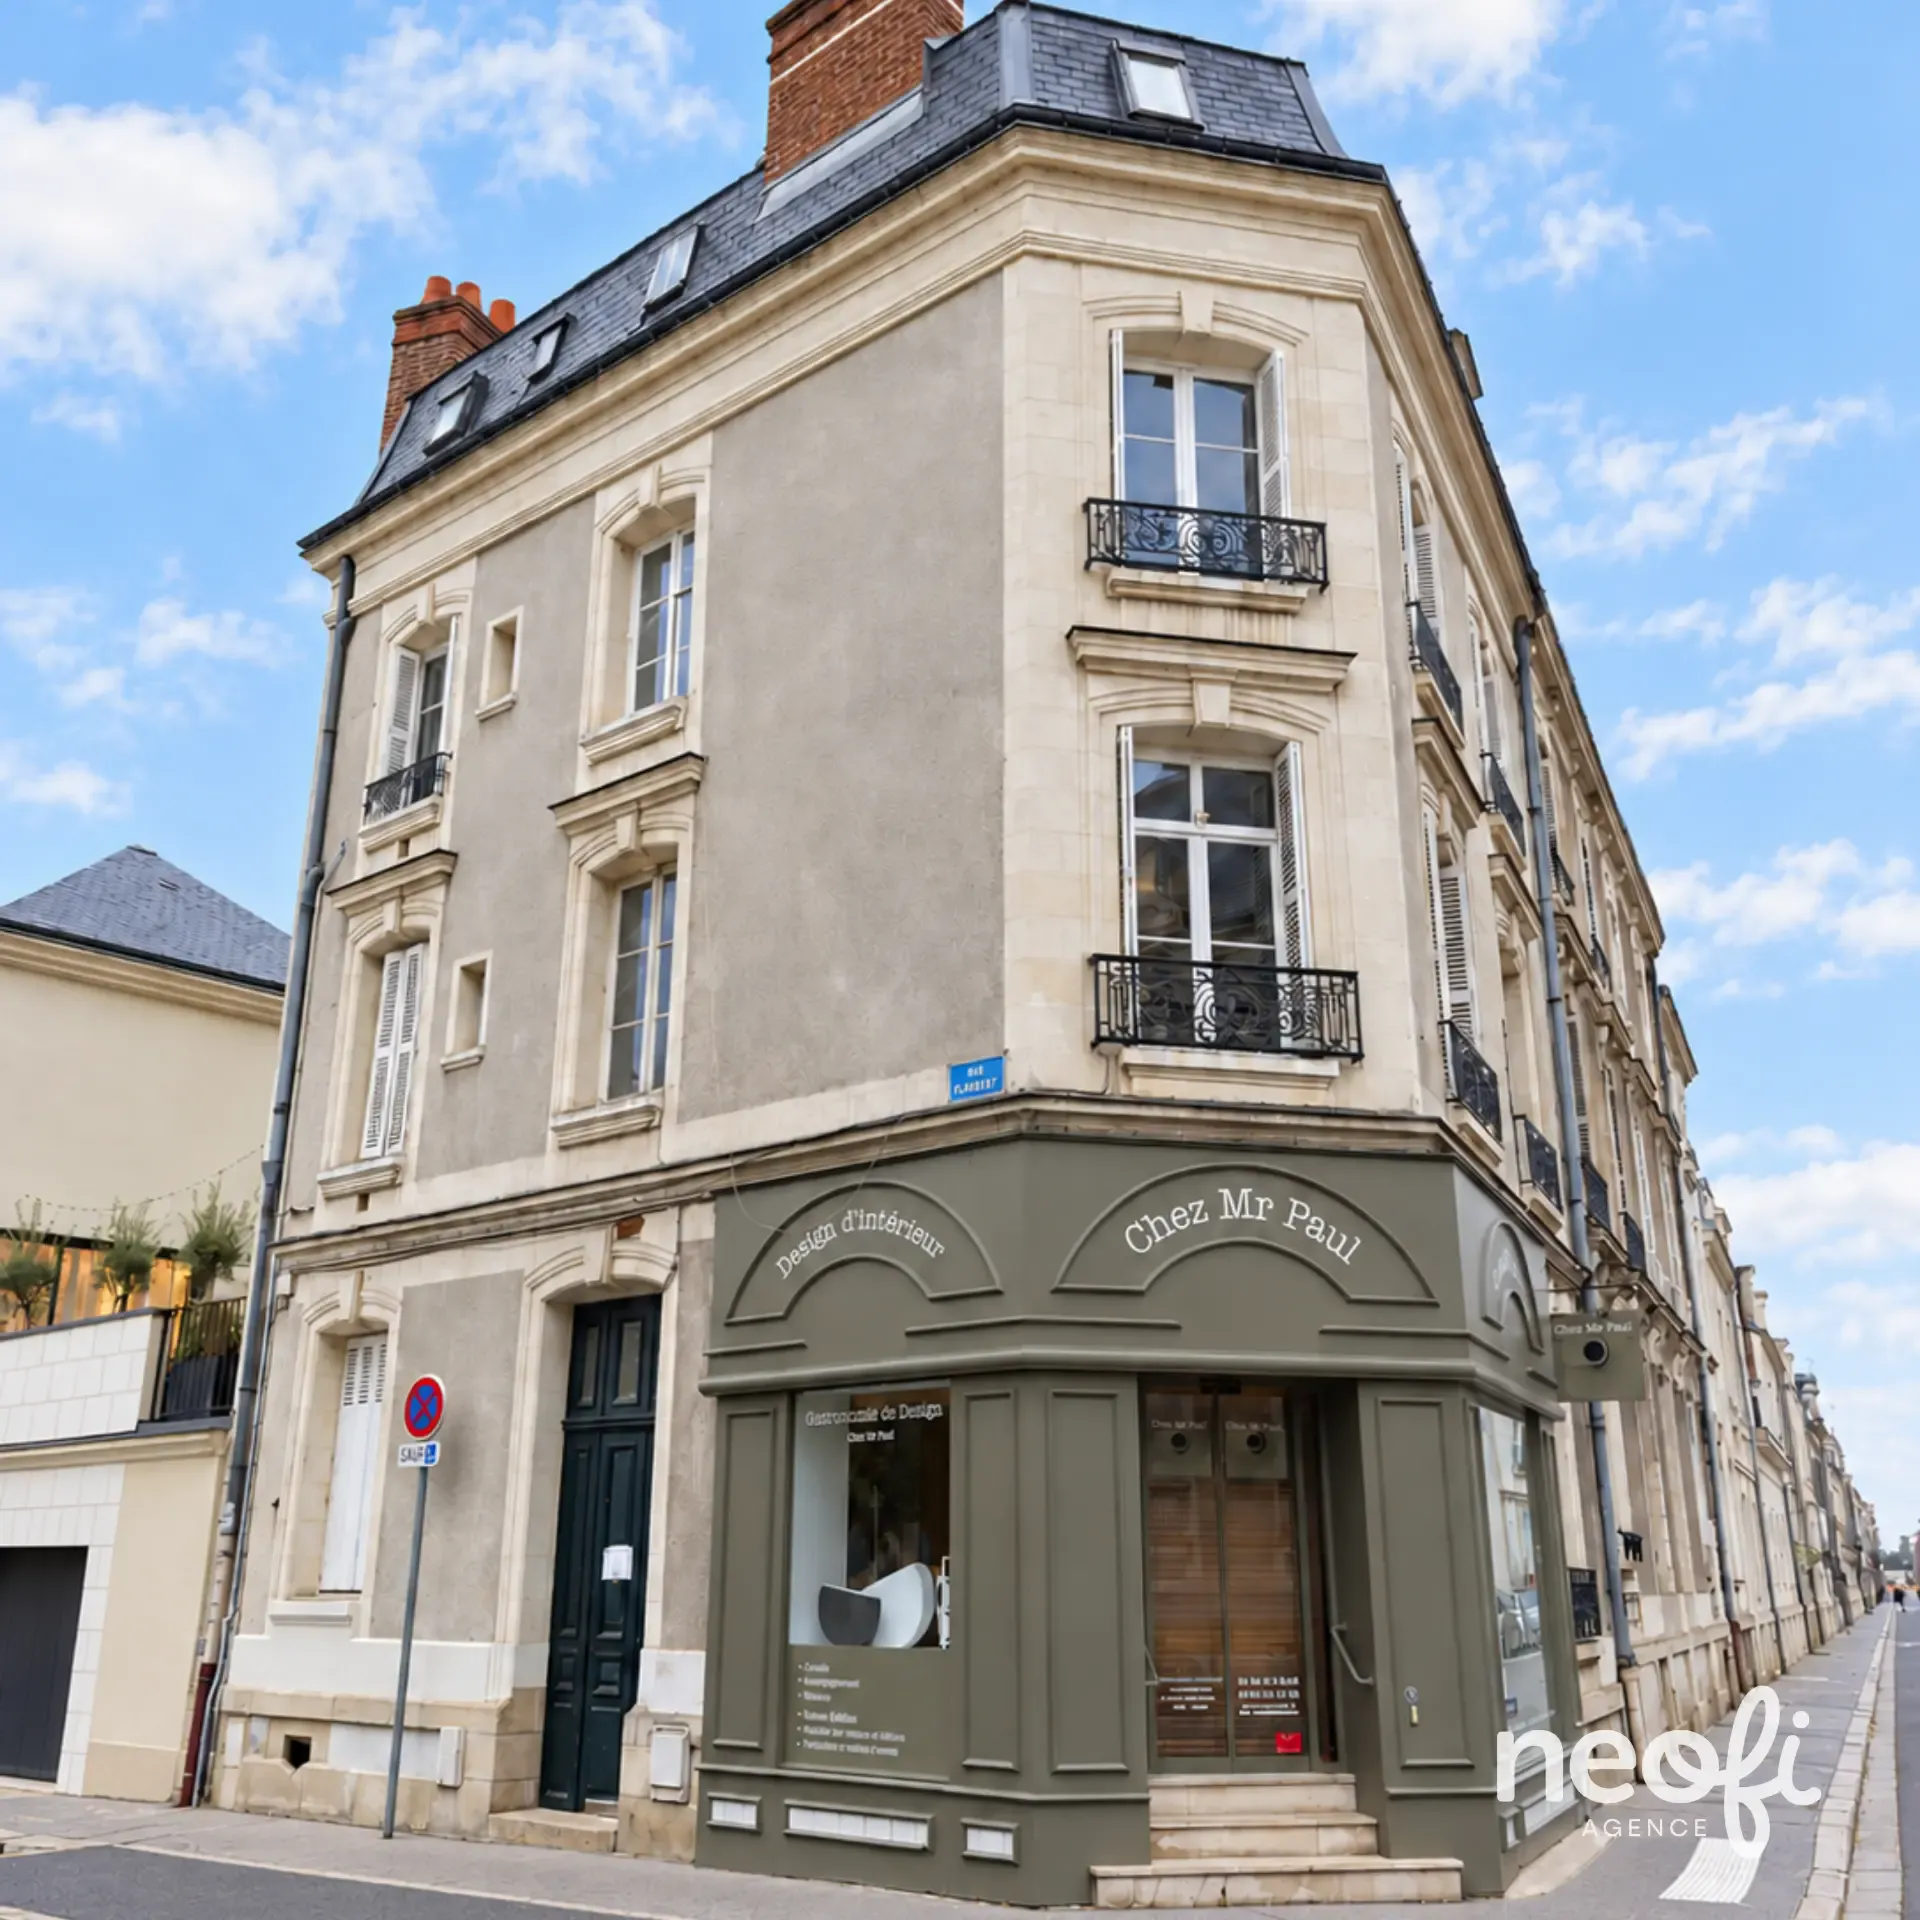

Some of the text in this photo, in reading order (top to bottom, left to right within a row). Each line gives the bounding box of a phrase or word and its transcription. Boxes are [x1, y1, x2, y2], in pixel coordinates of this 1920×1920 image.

[775, 1209, 945, 1279] Design d'intérieur
[1124, 1187, 1362, 1266] Chez Mr Paul
